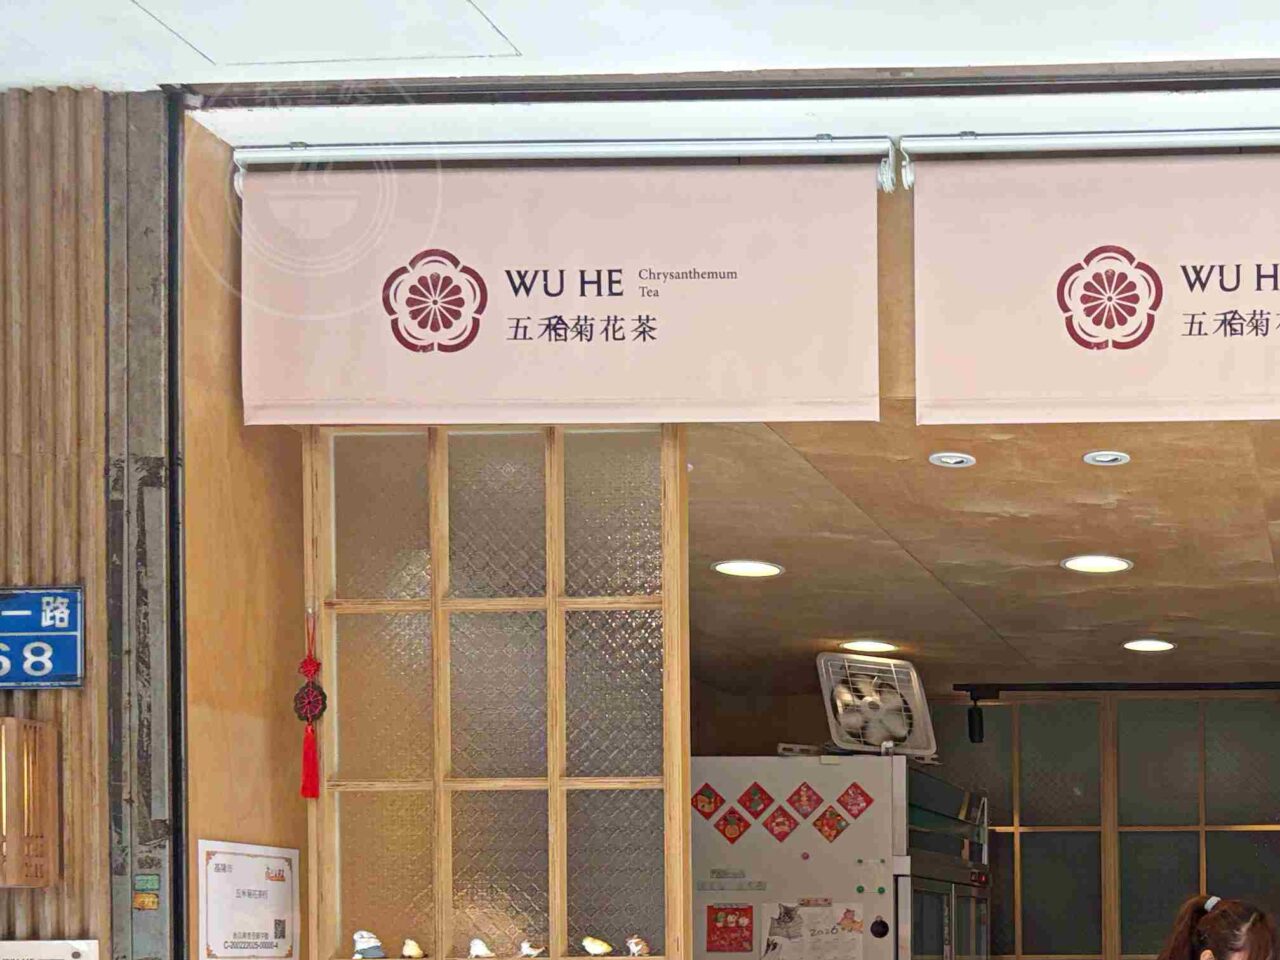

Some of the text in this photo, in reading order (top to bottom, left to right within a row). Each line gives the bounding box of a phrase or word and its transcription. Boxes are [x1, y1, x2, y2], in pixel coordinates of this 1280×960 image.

[504, 269, 624, 298] WU HE
[638, 268, 738, 283] Chrysanthemum
[1180, 263, 1242, 293] WU
[639, 286, 660, 298] Tea
